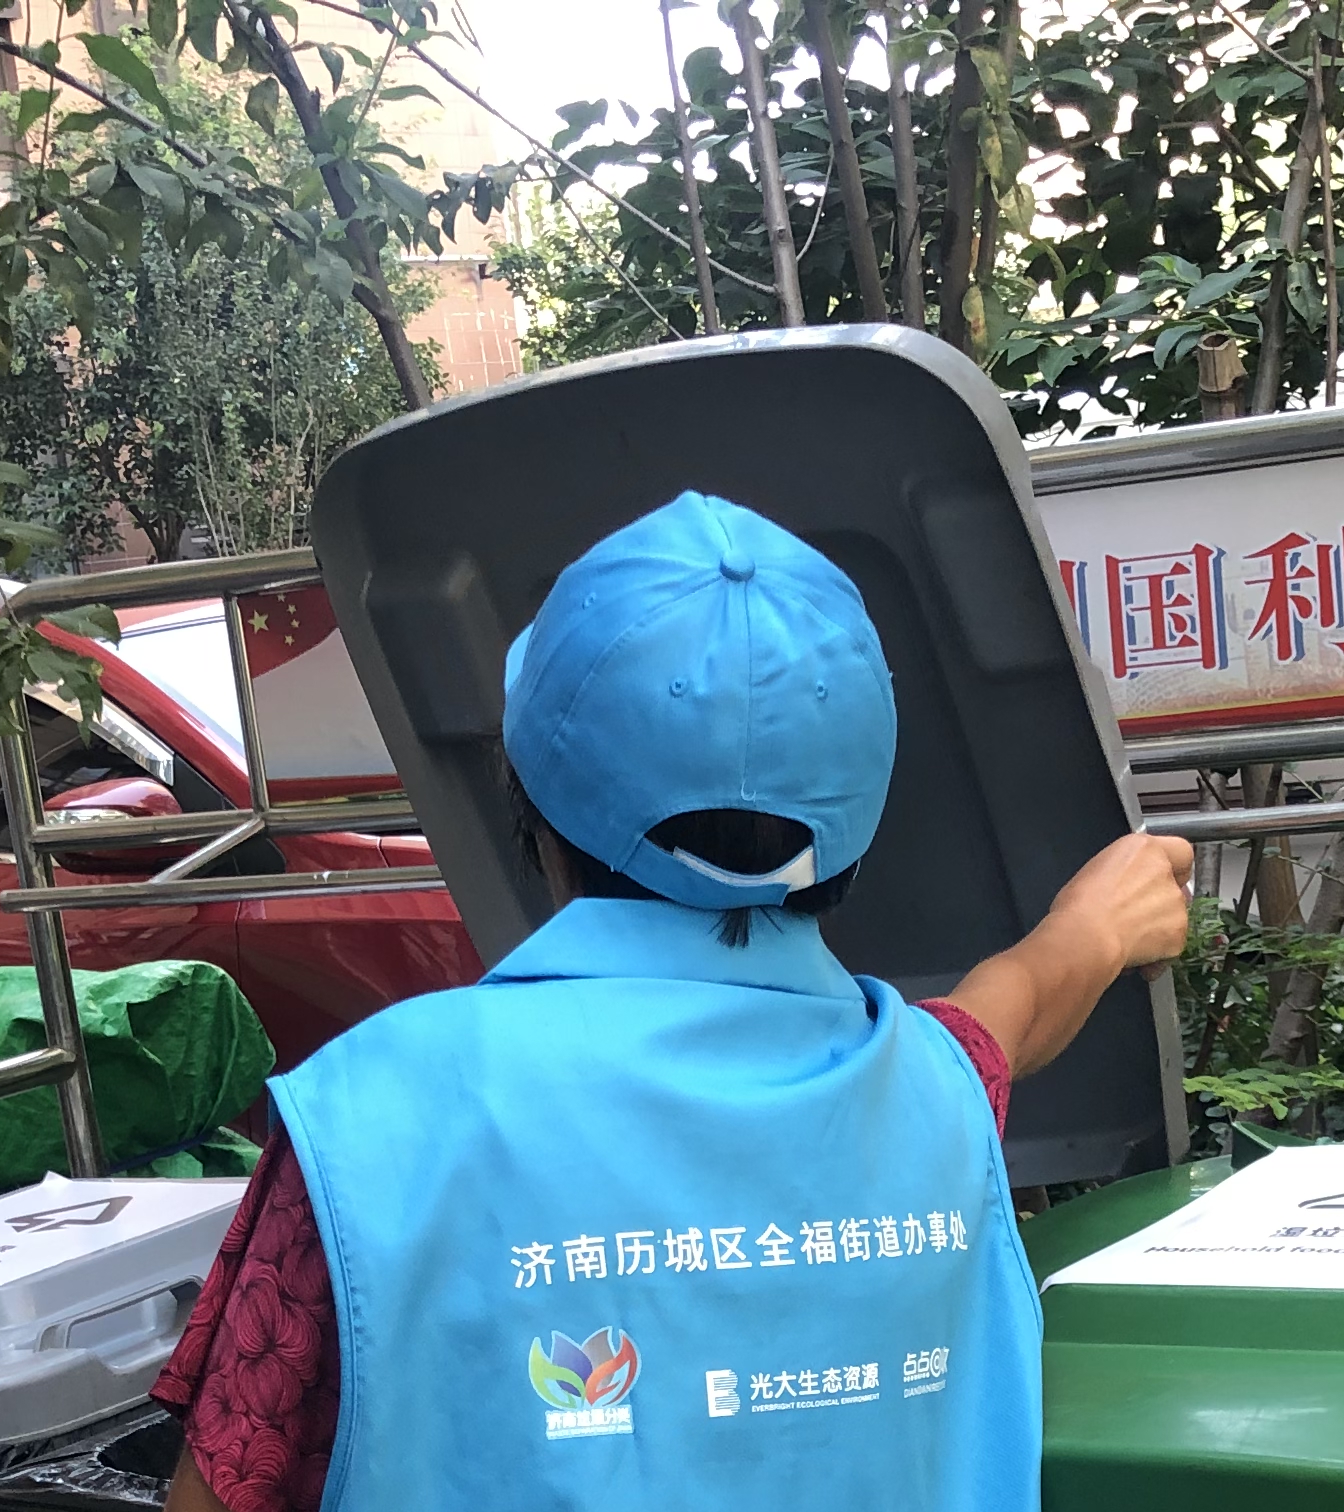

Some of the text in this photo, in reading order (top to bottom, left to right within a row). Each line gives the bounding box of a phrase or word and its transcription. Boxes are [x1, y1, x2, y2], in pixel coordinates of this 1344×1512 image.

[509, 1209, 969, 1290] 济南历城区全福街道办事处
[1143, 1245, 1286, 1254] Household
[749, 1361, 880, 1401] 光大生态资源
